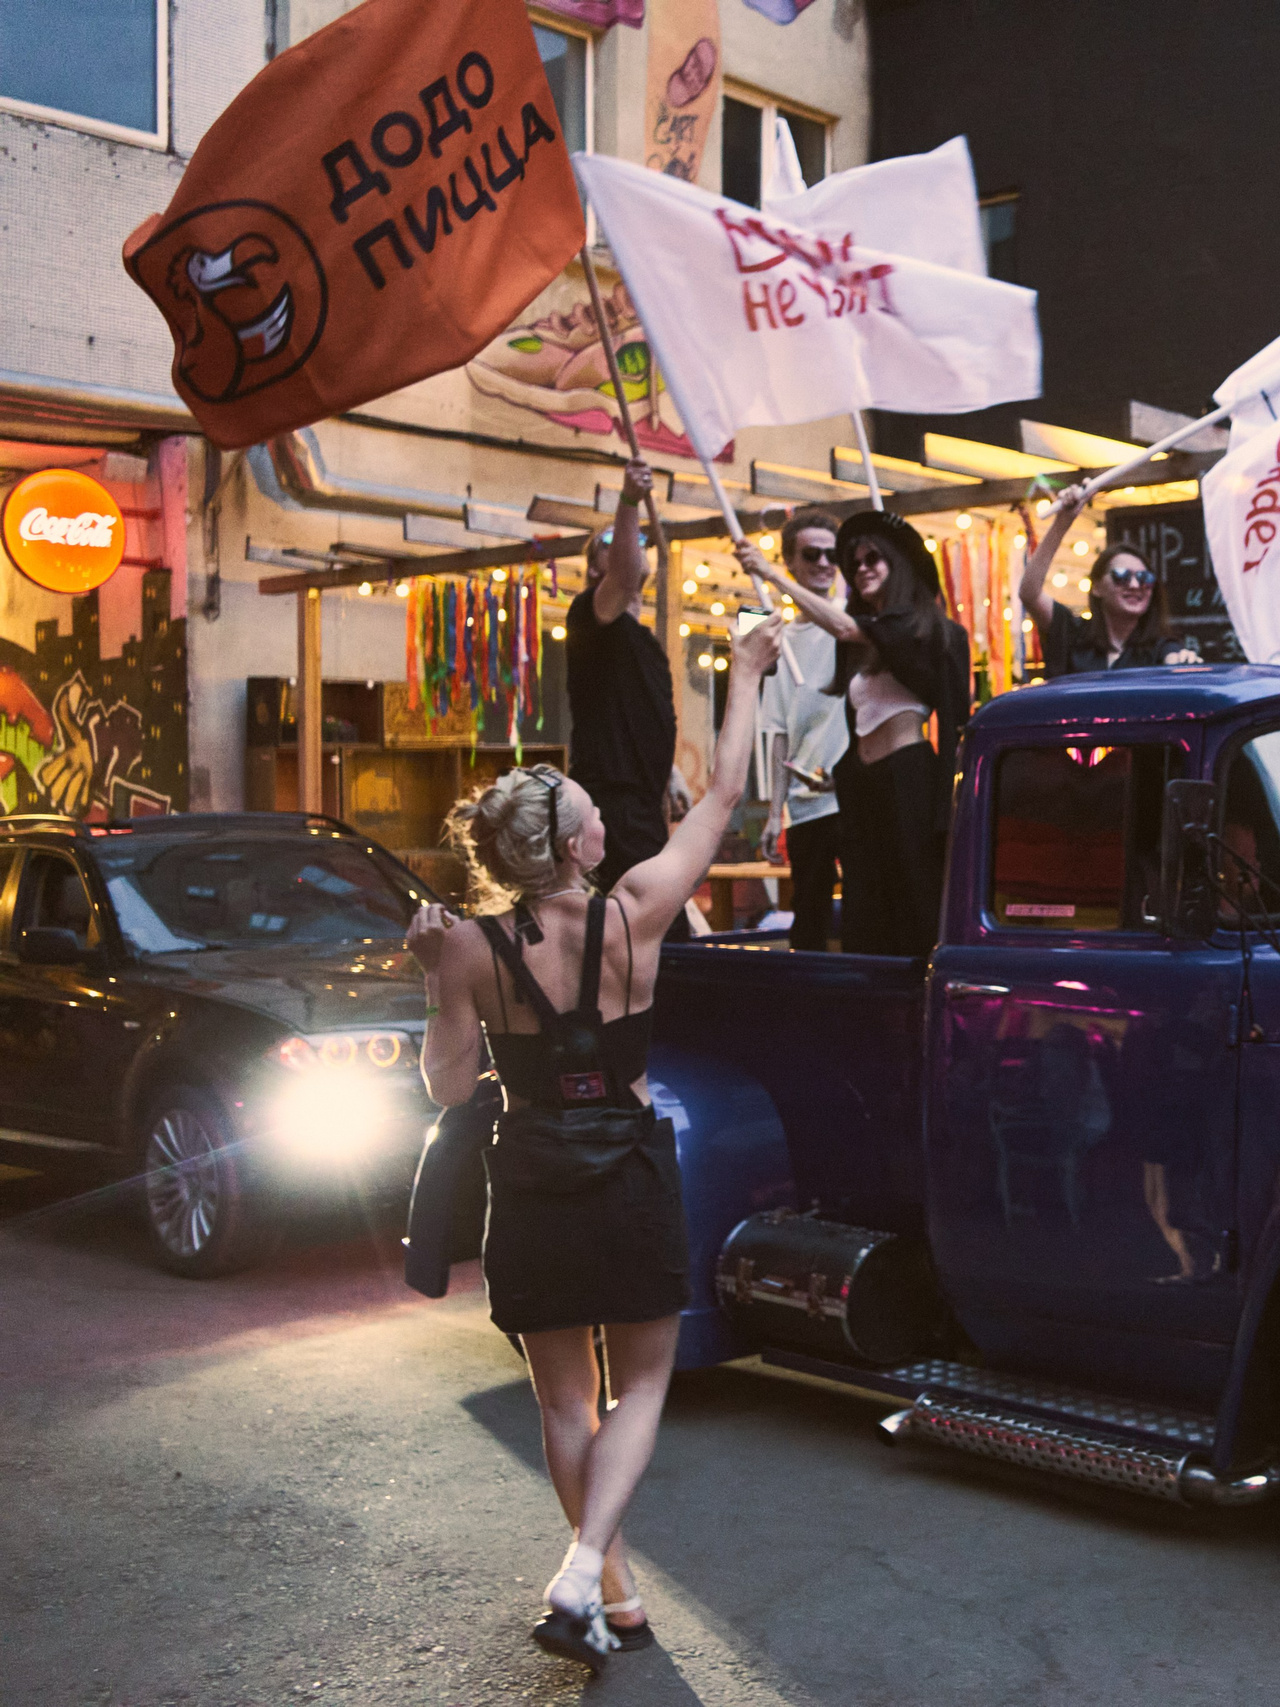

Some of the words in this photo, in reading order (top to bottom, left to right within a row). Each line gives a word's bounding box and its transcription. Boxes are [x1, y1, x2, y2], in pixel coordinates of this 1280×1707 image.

[321, 51, 494, 224] ДОДО
[353, 102, 556, 290] ПИЦЦА
[19, 507, 117, 548] Coca-Cola
